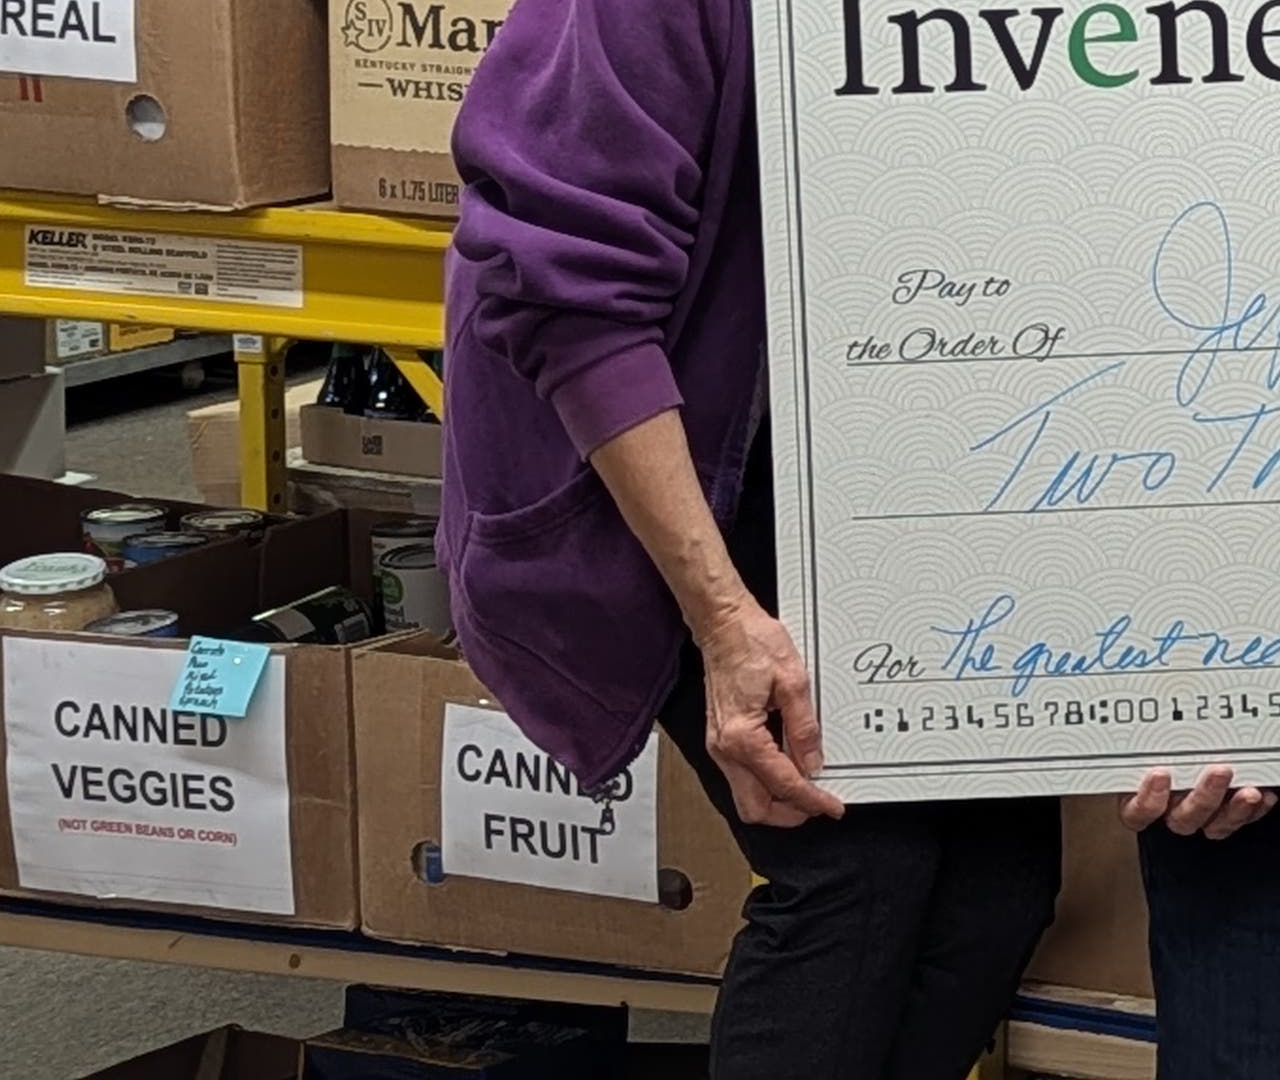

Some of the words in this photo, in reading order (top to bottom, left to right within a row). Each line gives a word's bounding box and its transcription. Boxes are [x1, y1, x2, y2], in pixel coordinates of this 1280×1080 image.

[355, 58, 417, 72] KENTUCKY
[28, 229, 88, 249] KELLER
[892, 268, 977, 306] Pay
[982, 276, 1012, 298] to
[846, 328, 893, 361] the
[898, 326, 1004, 362] Order
[1011, 323, 1066, 362] Of
[970, 360, 1176, 513] Two
[852, 641, 926, 683] For
[1011, 615, 1202, 697] greatest
[54, 700, 228, 748] CANNED
[51, 763, 235, 812] VEGGIES
[456, 743, 634, 803] CANND
[58, 819, 88, 833] (NOT
[91, 820, 133, 835] GREEN
[135, 823, 175, 840] BEANS
[177, 826, 196, 841] OR
[199, 829, 238, 847] CORN)
[483, 812, 602, 865] FRUIT
